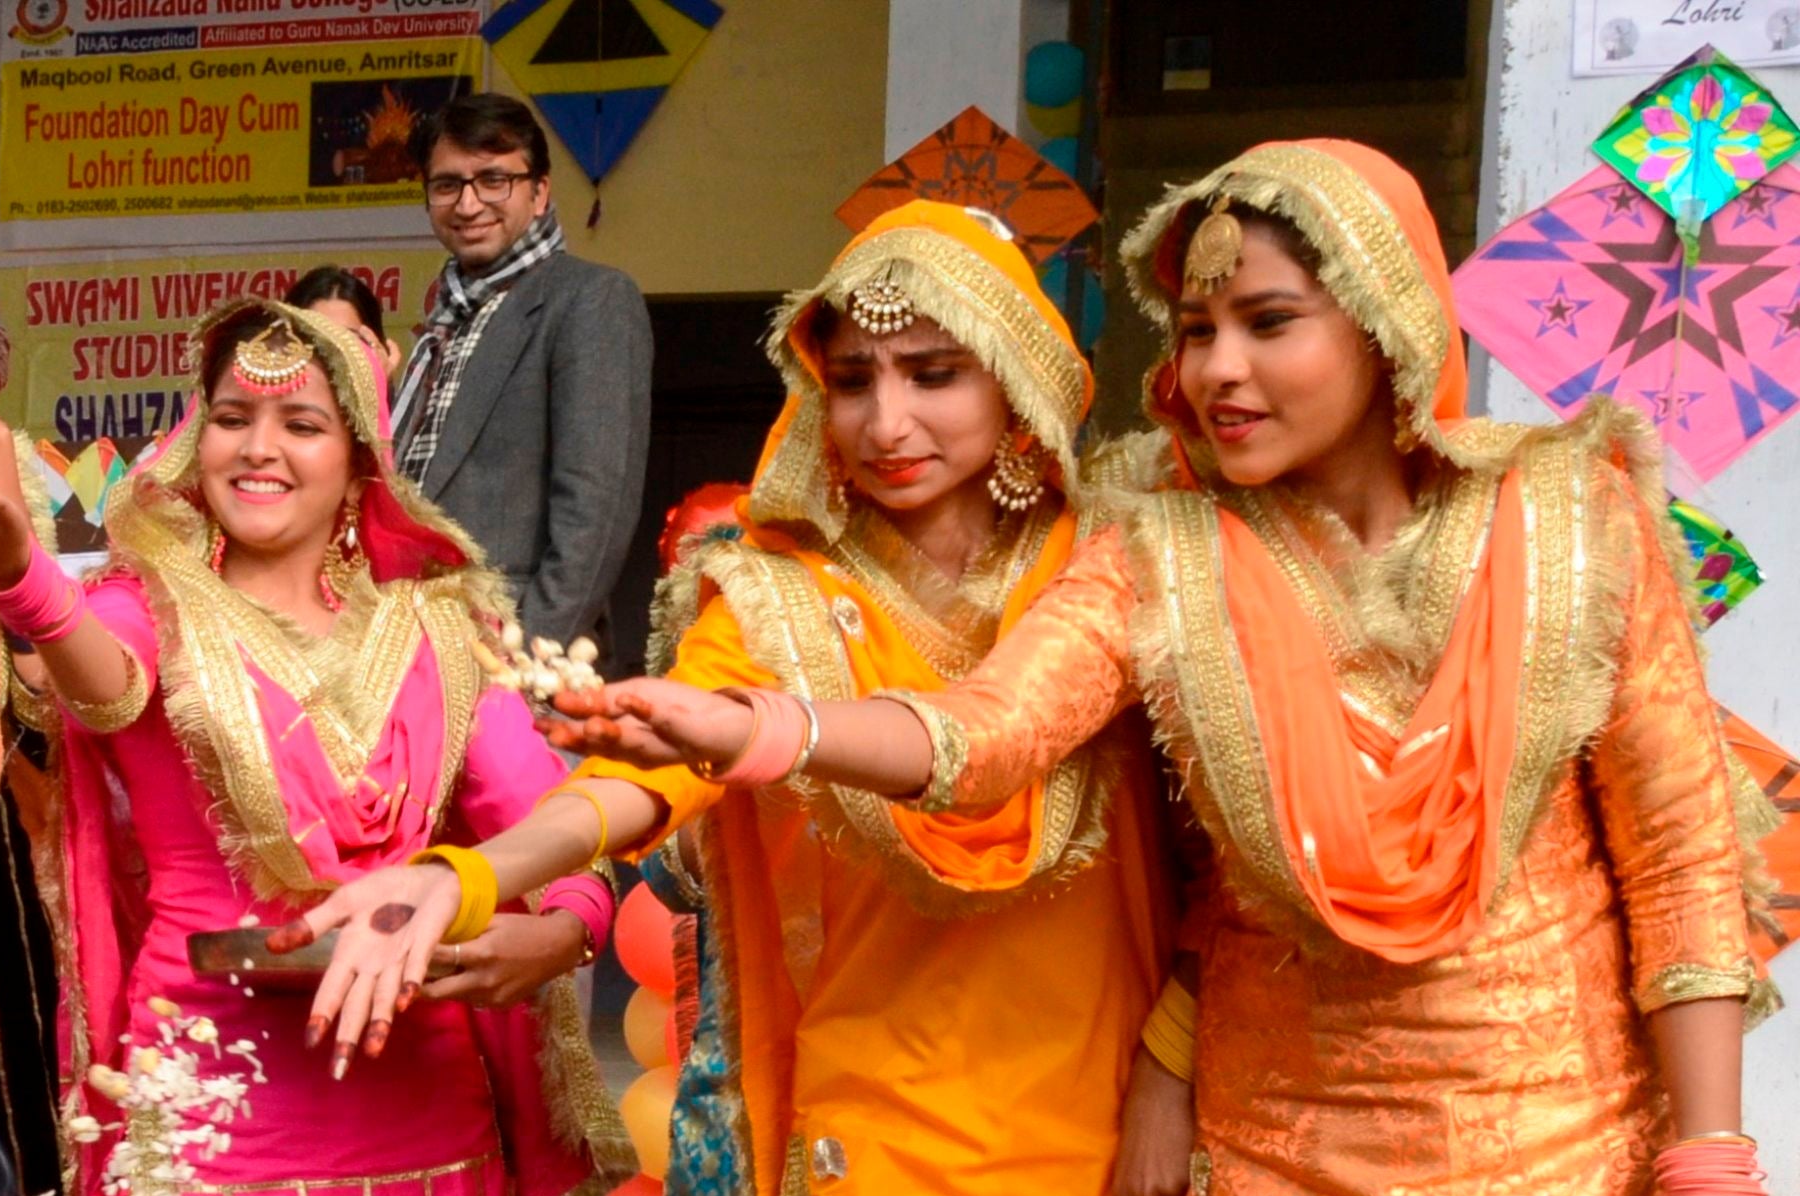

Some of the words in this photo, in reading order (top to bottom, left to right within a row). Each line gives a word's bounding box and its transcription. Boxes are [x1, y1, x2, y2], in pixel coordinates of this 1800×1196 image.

[205, 26, 265, 43] Affiliated
[269, 26, 283, 40] to
[287, 23, 322, 39] Guru
[325, 19, 369, 36] Nanak
[373, 19, 400, 35] Dev
[405, 16, 474, 35] University
[1661, 0, 1745, 25] Lohri
[79, 36, 119, 51] NAAC
[122, 31, 196, 50] Accredited
[20, 67, 112, 90] Maqbool
[119, 62, 182, 84] Road,
[189, 60, 256, 80] Green
[261, 56, 353, 76] Avenue,
[360, 50, 458, 72] Amritsar
[25, 99, 169, 142] Foundation
[180, 96, 230, 144] Day
[238, 93, 299, 133] Cum
[68, 149, 133, 189] Lohri
[142, 146, 251, 186] function
[26, 276, 139, 327] SWAMI
[152, 266, 400, 319] VIVEKANDA
